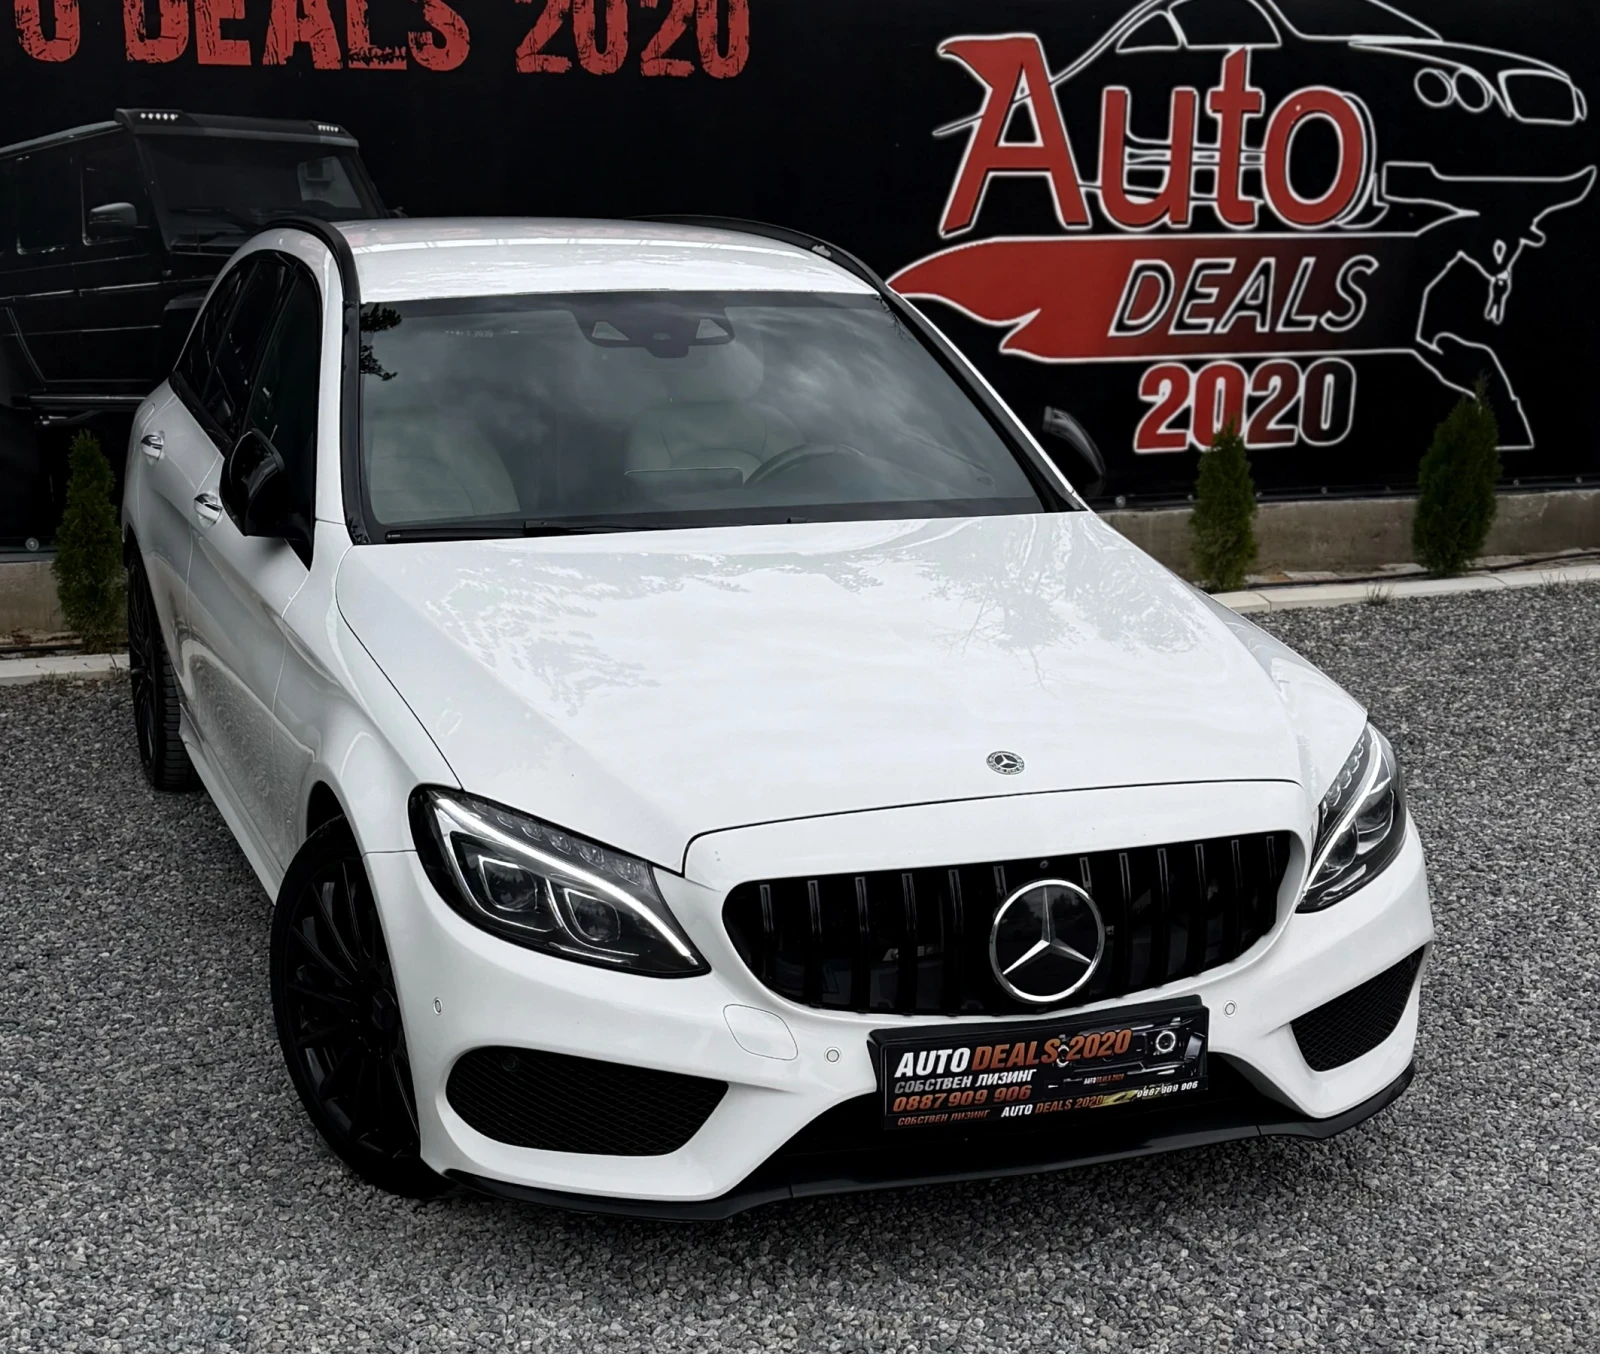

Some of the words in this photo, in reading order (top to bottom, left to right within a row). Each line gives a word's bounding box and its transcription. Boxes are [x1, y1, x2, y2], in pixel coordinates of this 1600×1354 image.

[123, 0, 470, 71] DEALS
[515, 0, 750, 79] 2020
[936, 34, 1368, 238] Auto
[1107, 255, 1379, 336] DEALS
[1134, 358, 1357, 453] 2020
[894, 1047, 970, 1077] AUTO
[971, 1038, 1061, 1070] DEALS
[1066, 1029, 1132, 1061] 2020
[893, 1093, 947, 1111] 0887
[948, 1089, 988, 1107] 909
[993, 1085, 1033, 1103] 906
[894, 1076, 973, 1094] СОБСТВЕН
[975, 1069, 1038, 1088] ЛИЗИНГ
[897, 1114, 949, 1127] СОБСТВЕН
[950, 1110, 990, 1121] ЛИЗИНГ
[1000, 1104, 1033, 1118] AUTO
[1034, 1099, 1074, 1114] DEALS
[1074, 1095, 1104, 1109] 2020
